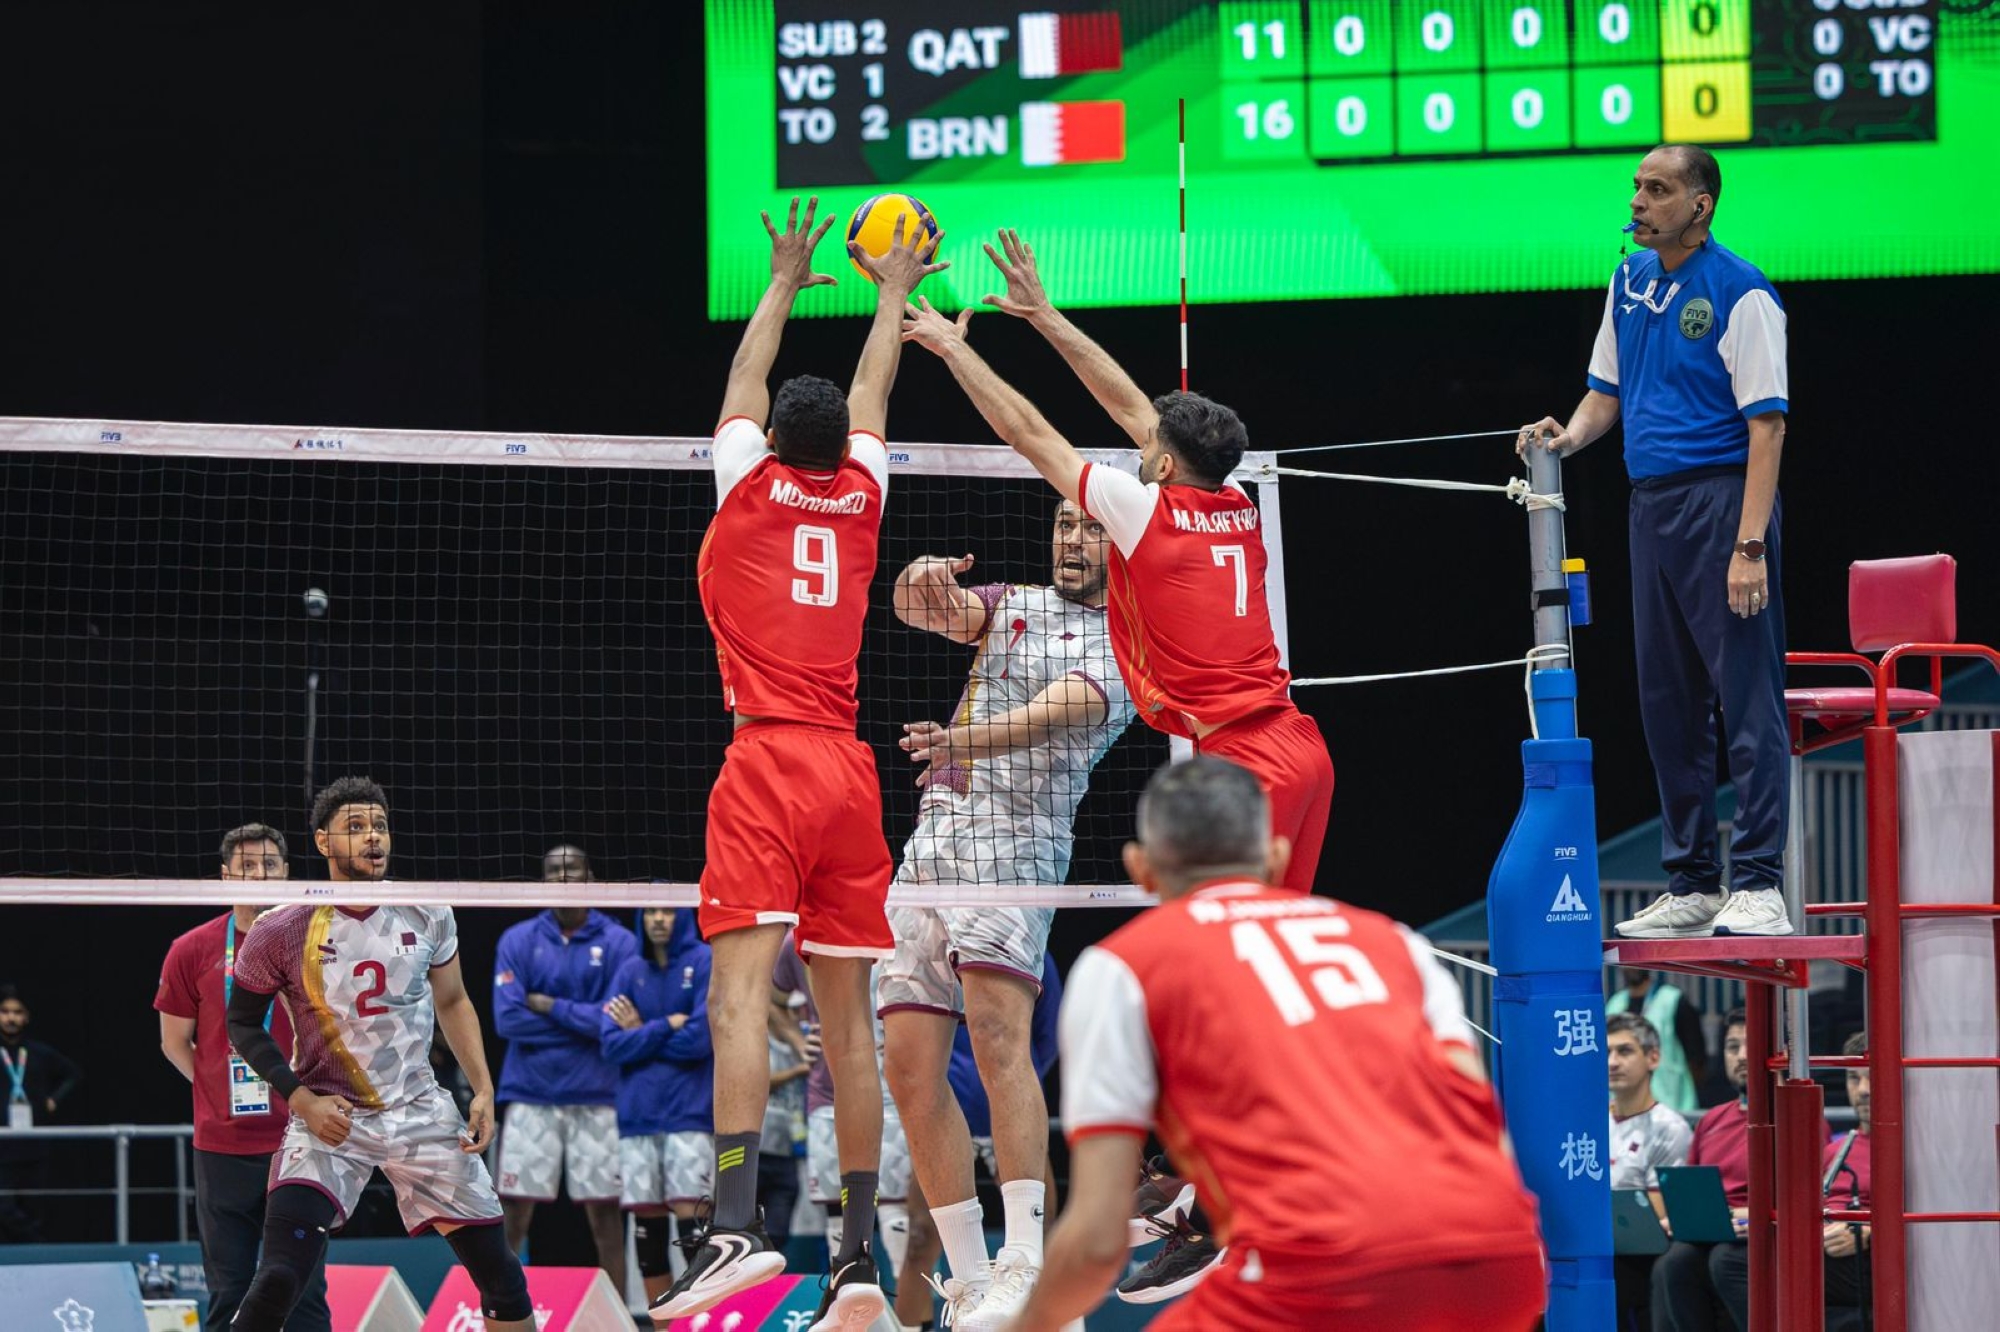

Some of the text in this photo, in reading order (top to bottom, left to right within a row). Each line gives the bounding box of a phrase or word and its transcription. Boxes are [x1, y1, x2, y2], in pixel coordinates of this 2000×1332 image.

[778, 19, 888, 59] SUB 2
[908, 2, 1717, 77] QAT 11 0 0 0 0 0
[1813, 14, 1931, 55] 0 VC
[778, 62, 884, 101] VC 1
[1813, 59, 1932, 100] 0 TO
[778, 104, 890, 144] TO 2
[907, 83, 1719, 160] BRN 16 0 0 0 0 0
[1685, 308, 1708, 320] FIVB
[506, 444, 526, 453] FIVB
[889, 453, 909, 461] FIVB
[791, 524, 839, 608] 9
[1210, 544, 1248, 617] 7
[1554, 847, 1578, 857] FIVB
[353, 960, 389, 1018] 2
[1230, 915, 1389, 1027] 15
